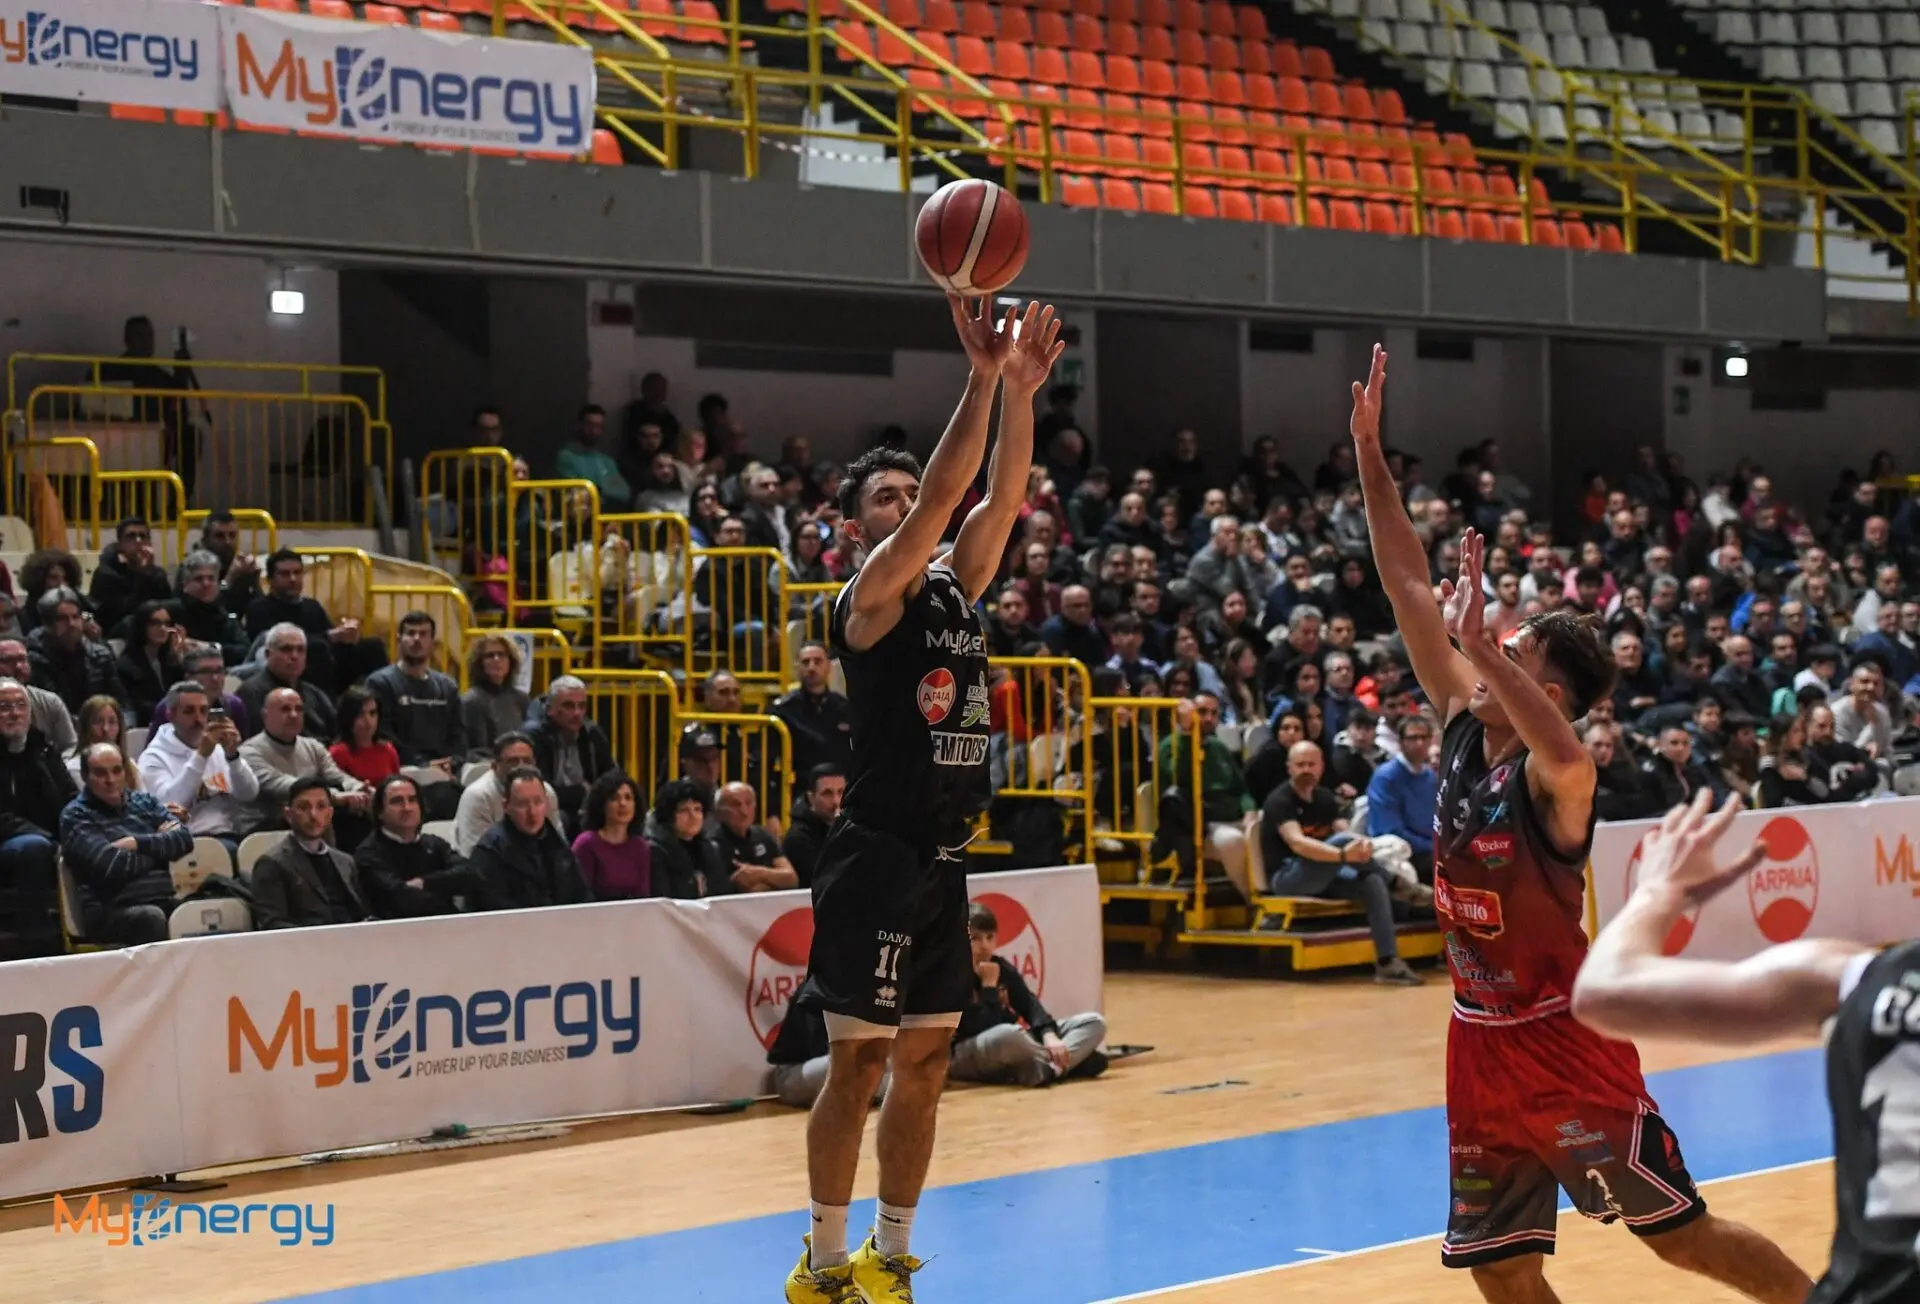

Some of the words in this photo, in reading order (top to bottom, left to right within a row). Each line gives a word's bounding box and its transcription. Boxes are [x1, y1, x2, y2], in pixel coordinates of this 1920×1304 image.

[0, 11, 198, 81] yEnergy
[416, 1057, 457, 1077] POWER
[459, 1056, 476, 1072] UP
[478, 1053, 509, 1070] YOUR
[510, 1046, 566, 1066] BUSINESS
